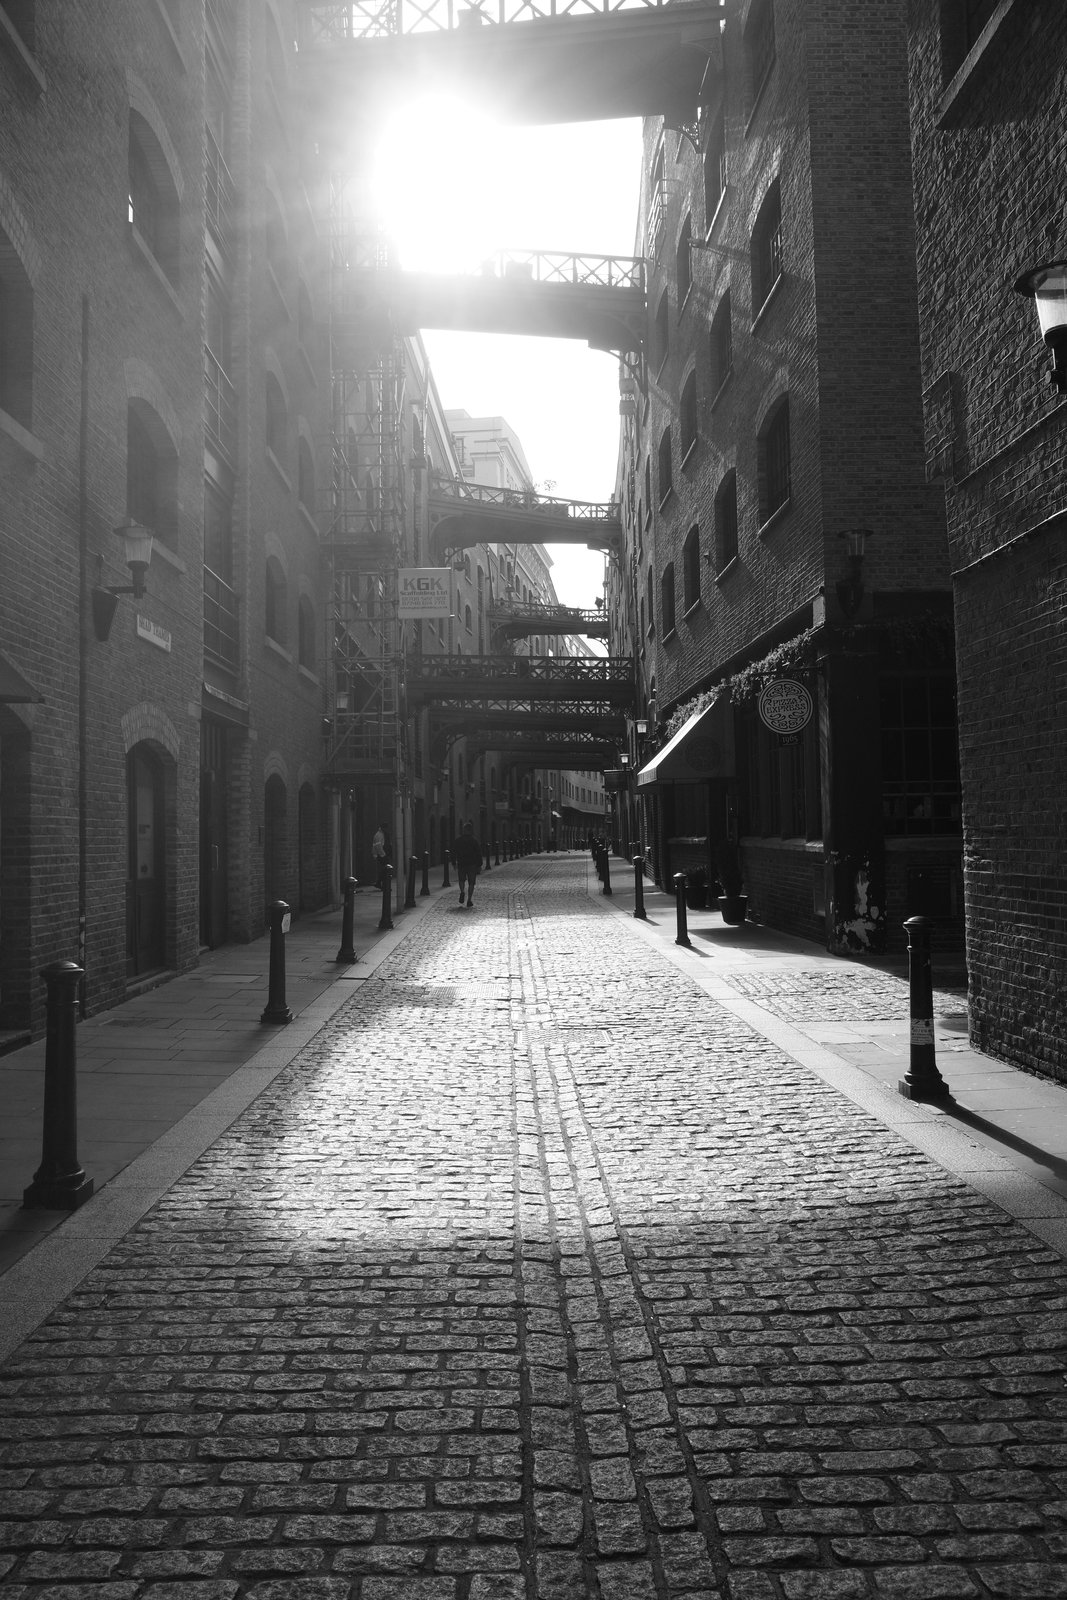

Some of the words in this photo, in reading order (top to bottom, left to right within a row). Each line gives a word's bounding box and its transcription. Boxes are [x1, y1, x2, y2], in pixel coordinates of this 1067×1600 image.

[404, 577, 443, 590] KGK
[773, 698, 798, 706] PIZZA
[767, 703, 806, 713] EXPRESS
[782, 735, 799, 744] 1965
